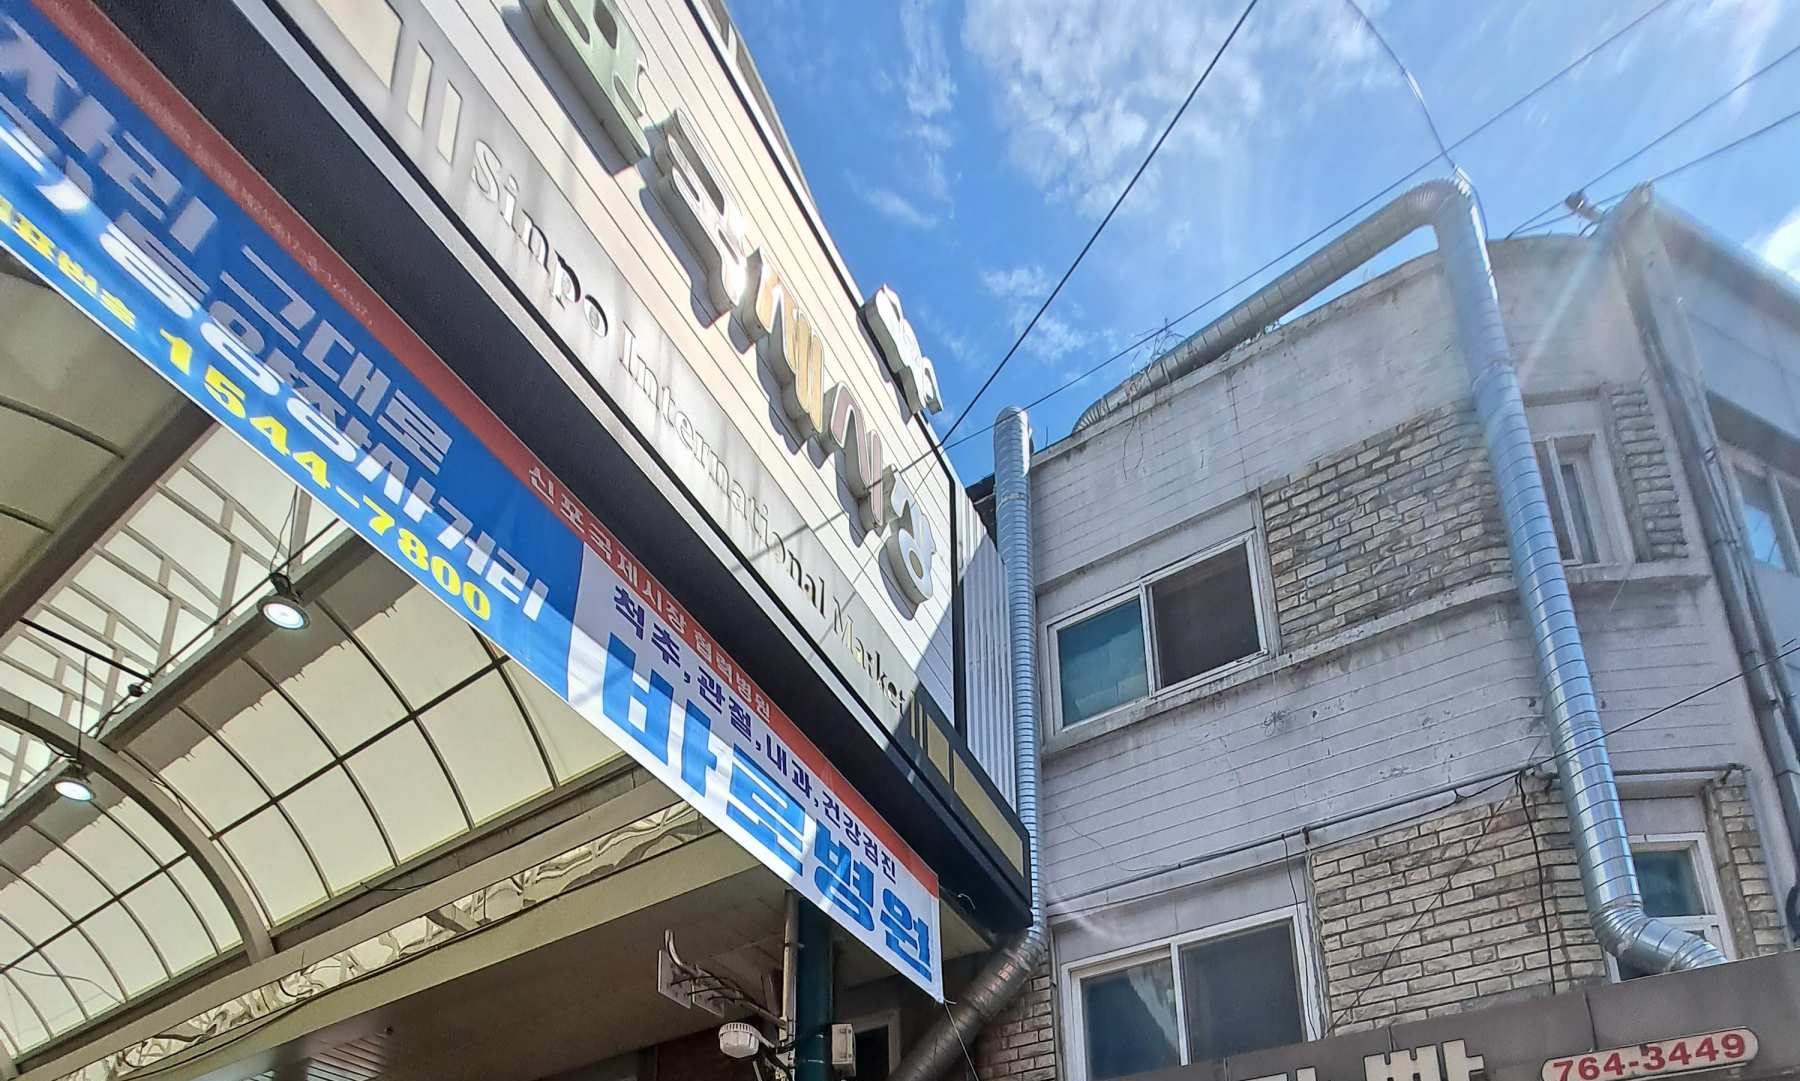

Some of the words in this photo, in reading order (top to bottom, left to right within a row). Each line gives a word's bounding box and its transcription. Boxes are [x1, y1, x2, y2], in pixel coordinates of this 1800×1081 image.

[159, 327, 493, 622] 1544-7800
[220, 245, 454, 476] 그대로
[470, 139, 609, 338] Sinpo
[619, 320, 826, 620] International
[832, 594, 906, 718] Market
[528, 466, 688, 636] 신포국제시장
[694, 627, 772, 725] 협력병원
[613, 584, 898, 885] 척추,관절,내과,건강검진
[602, 630, 934, 985] 바로병원
